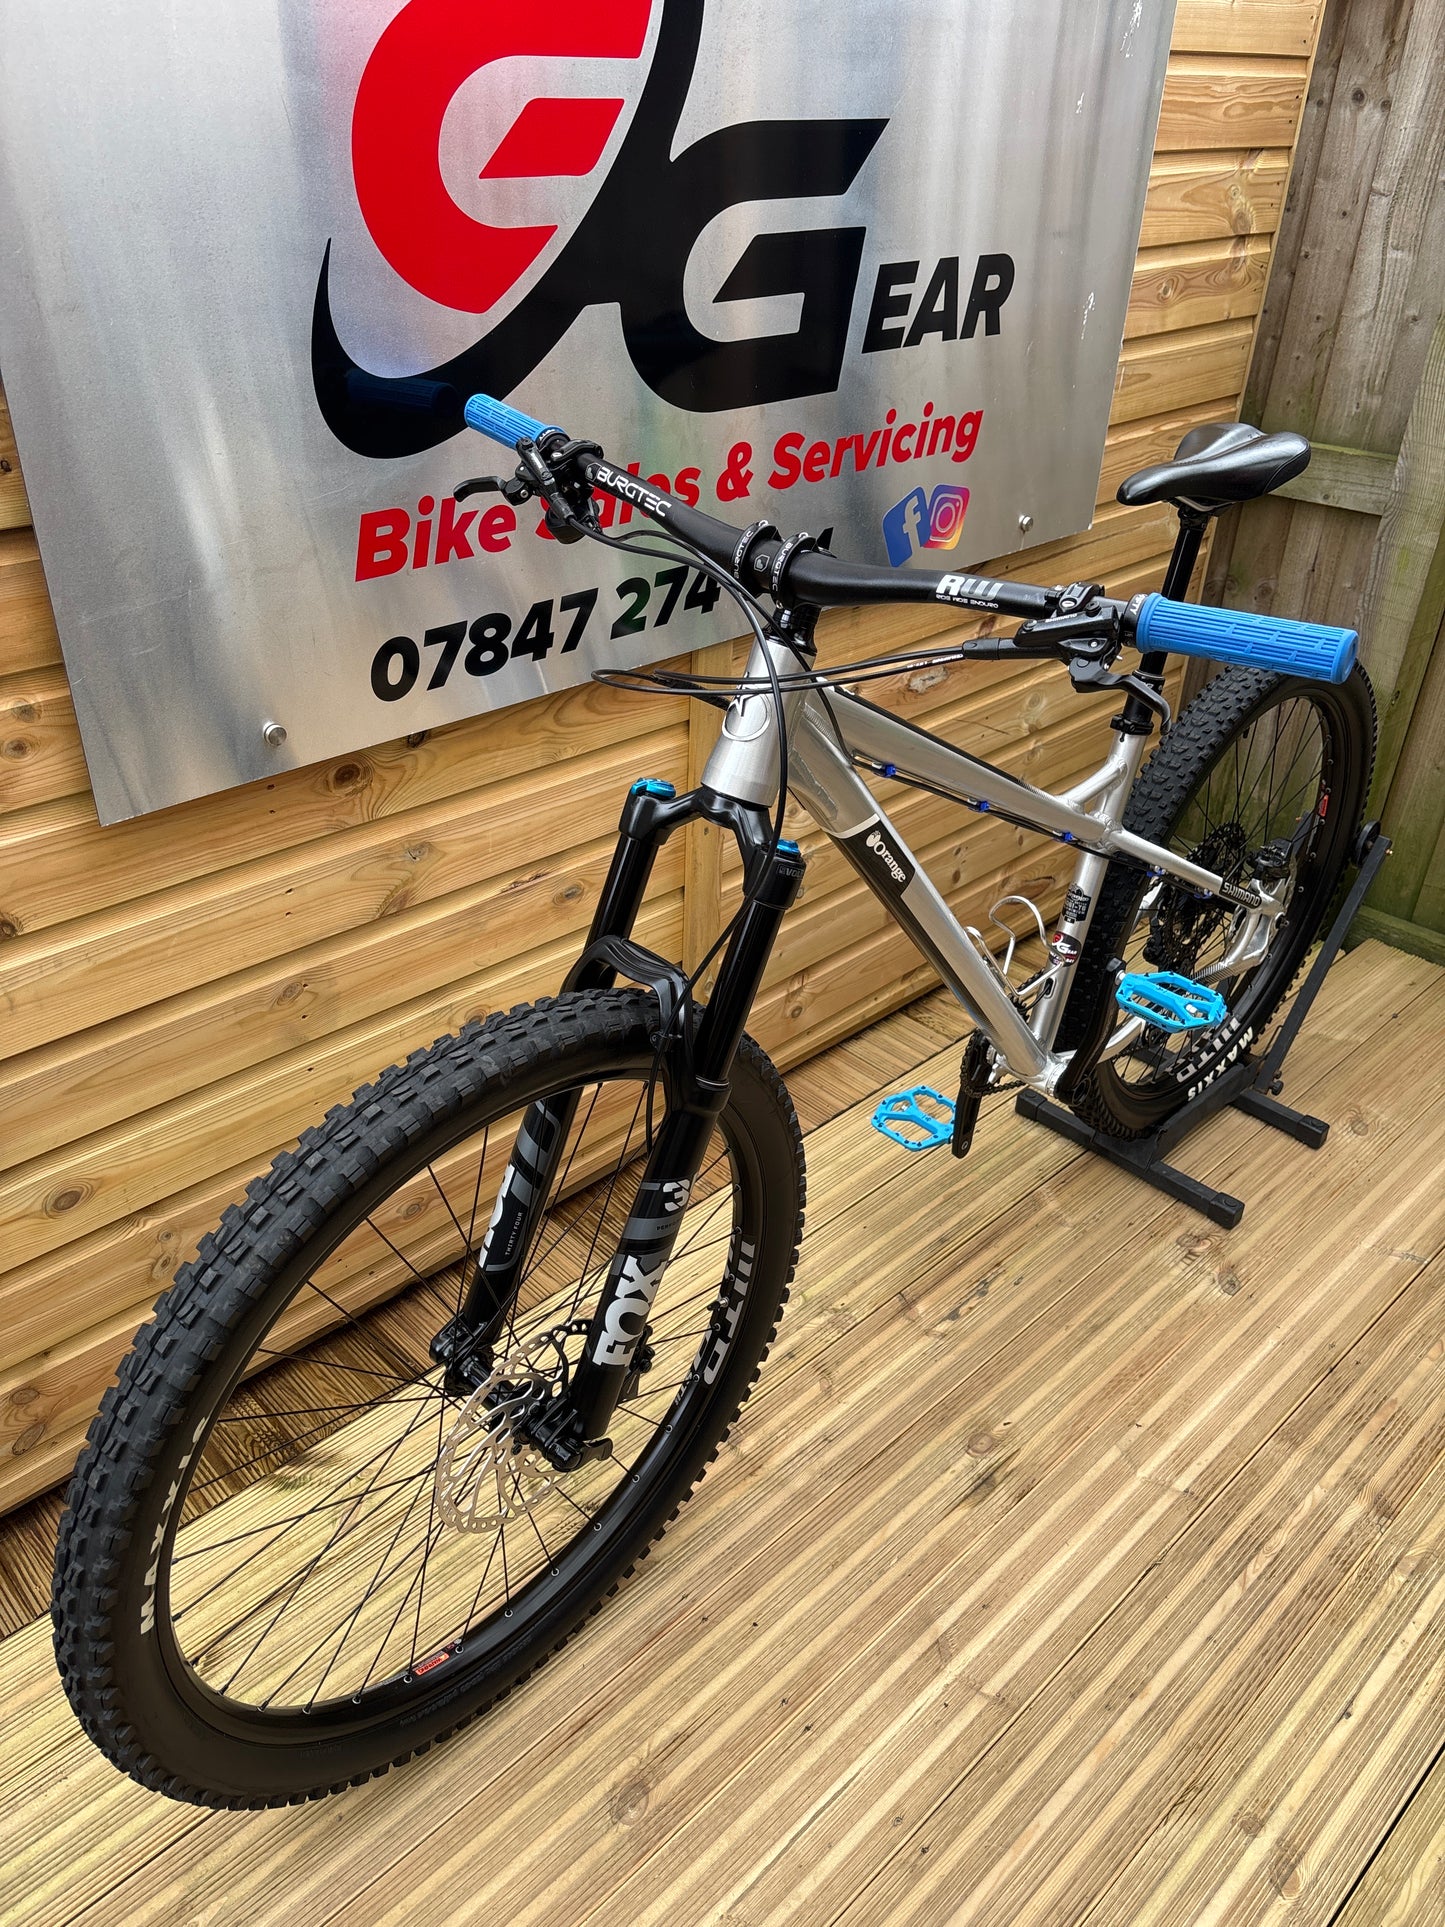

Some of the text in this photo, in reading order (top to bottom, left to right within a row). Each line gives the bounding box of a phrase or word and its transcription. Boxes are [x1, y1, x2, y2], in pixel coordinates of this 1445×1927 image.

[354, 494, 517, 582] Bike
[715, 440, 754, 503] &
[767, 401, 985, 491] Servicing
[597, 466, 673, 518] BURGTEC
[733, 530, 755, 579] BURGTEC
[772, 541, 794, 592] BURGTEC
[935, 574, 1004, 601] RW
[370, 565, 722, 703] 07847 274
[872, 840, 907, 883] Orange
[1221, 881, 1261, 907] SHIMANO
[1187, 1026, 1254, 1102] MAXXIS
[504, 1211, 524, 1256] THIRTY FOUR
[592, 1254, 668, 1366] FOX
